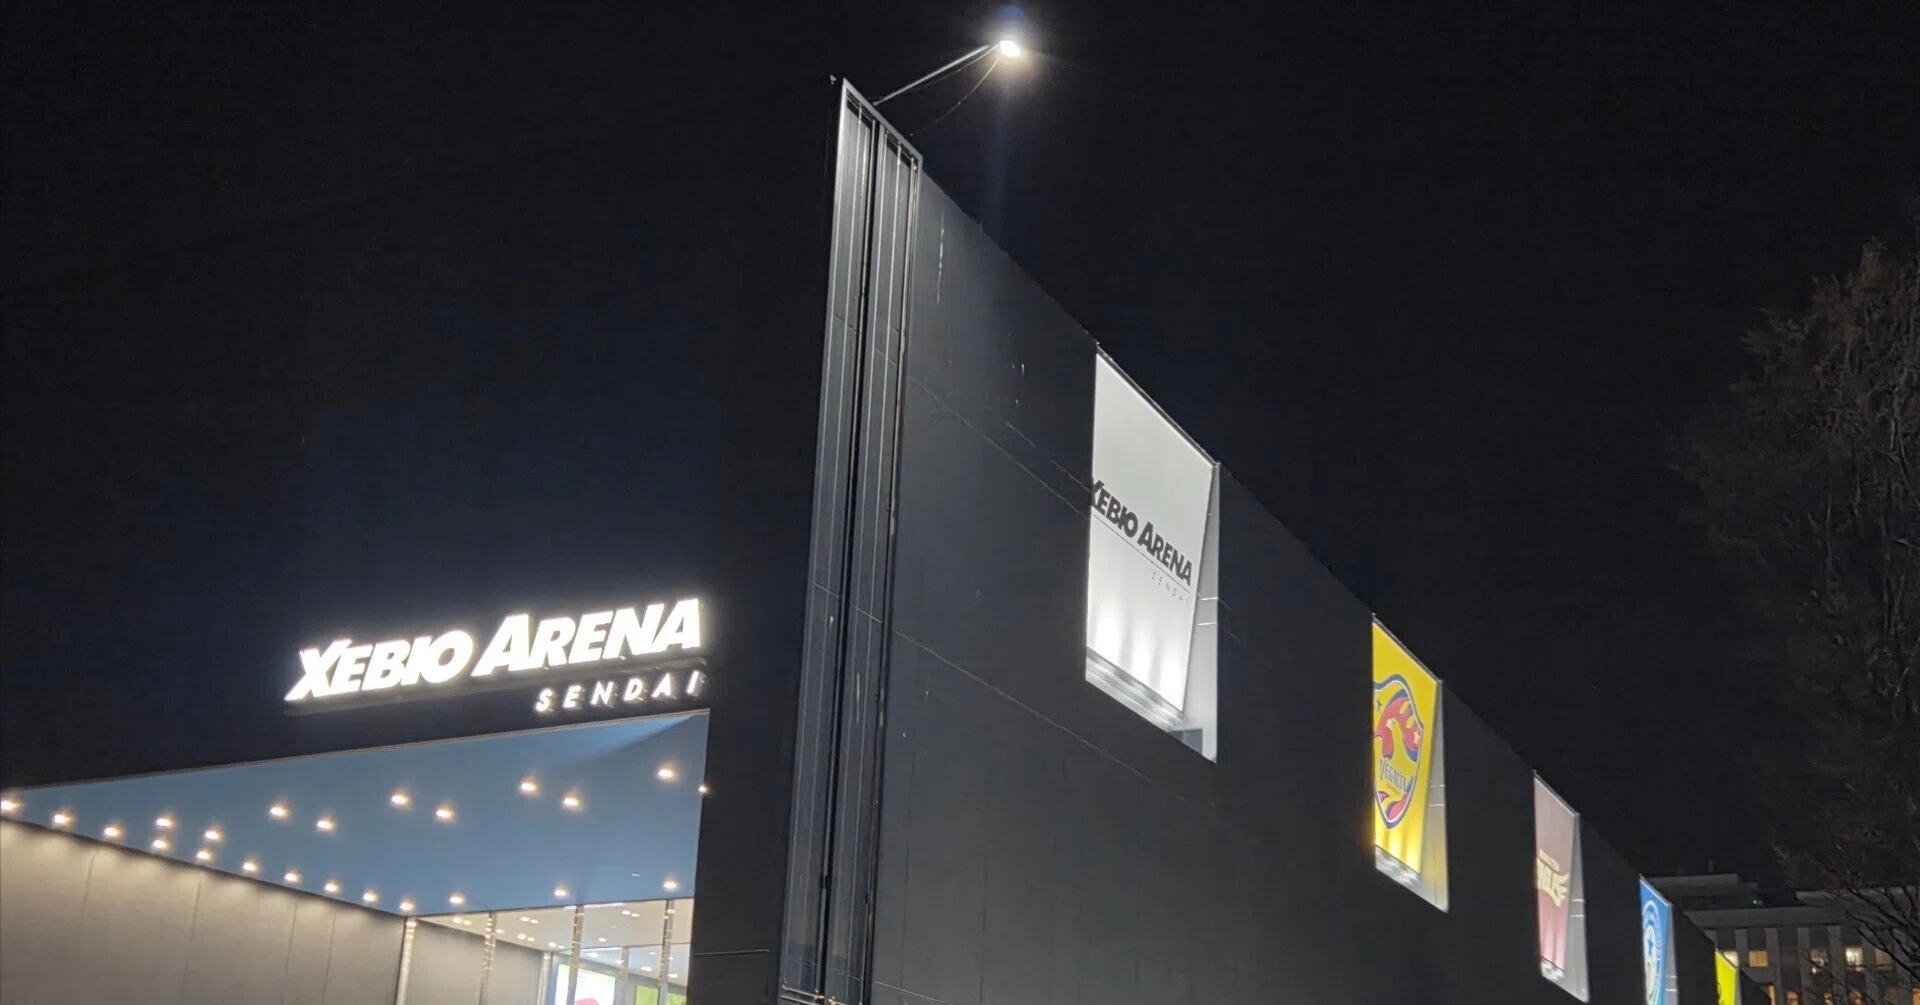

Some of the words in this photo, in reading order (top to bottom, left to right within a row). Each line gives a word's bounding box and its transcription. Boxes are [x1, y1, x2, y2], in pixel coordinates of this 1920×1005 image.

[1138, 522, 1192, 586] ARENA
[284, 631, 473, 701] XEBIO
[472, 598, 700, 676] ARENA
[535, 671, 704, 713] SENDAI
